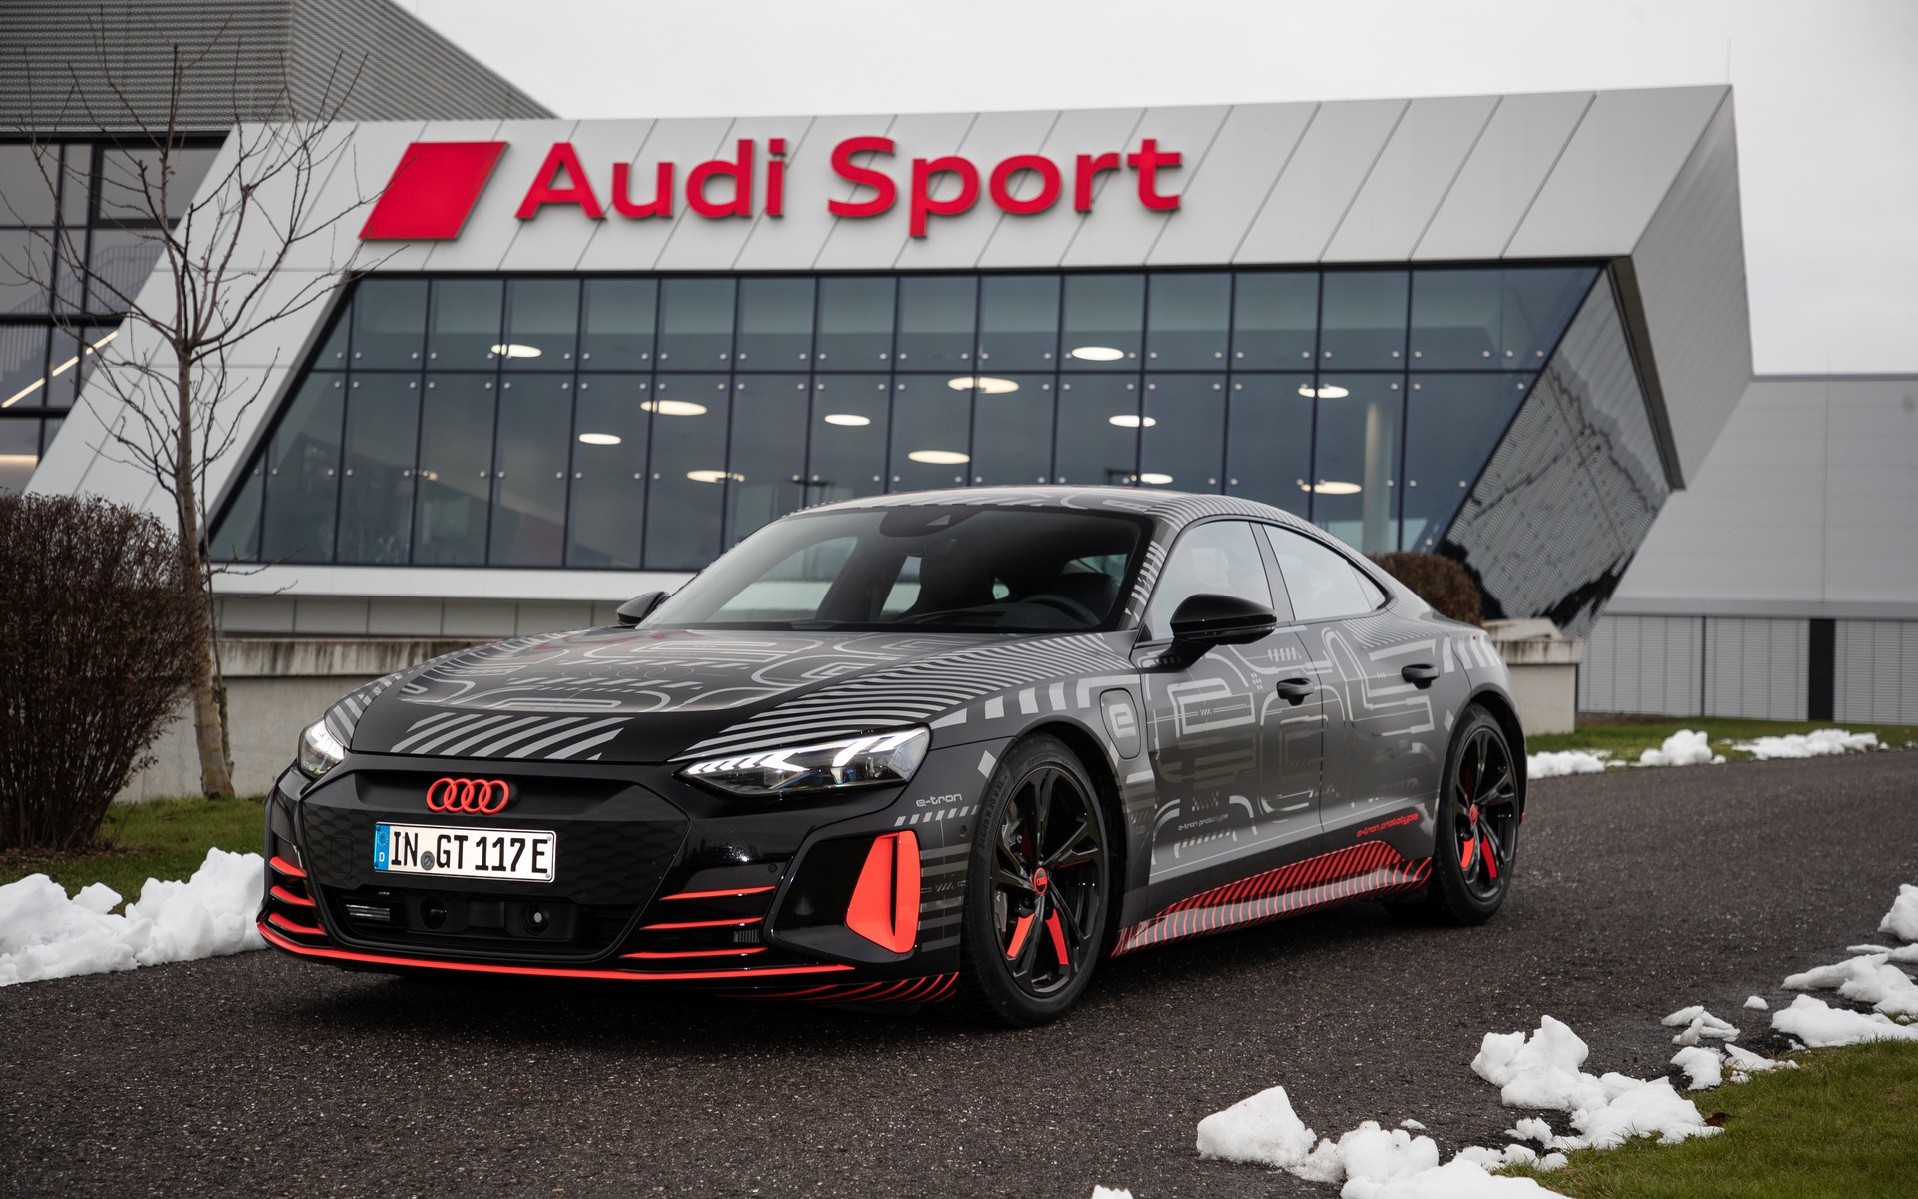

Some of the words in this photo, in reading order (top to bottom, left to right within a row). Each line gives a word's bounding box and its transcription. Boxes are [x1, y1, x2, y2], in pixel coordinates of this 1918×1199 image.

[513, 138, 787, 220] Audi
[828, 136, 1182, 238] Sport
[916, 794, 962, 807] e-tron
[988, 799, 996, 809] 20
[1178, 821, 1198, 831] e-tron
[1356, 824, 1380, 837] e-tron
[1380, 812, 1419, 831] prototype
[378, 851, 386, 862] D
[391, 831, 419, 867] IN
[436, 834, 469, 870] GT
